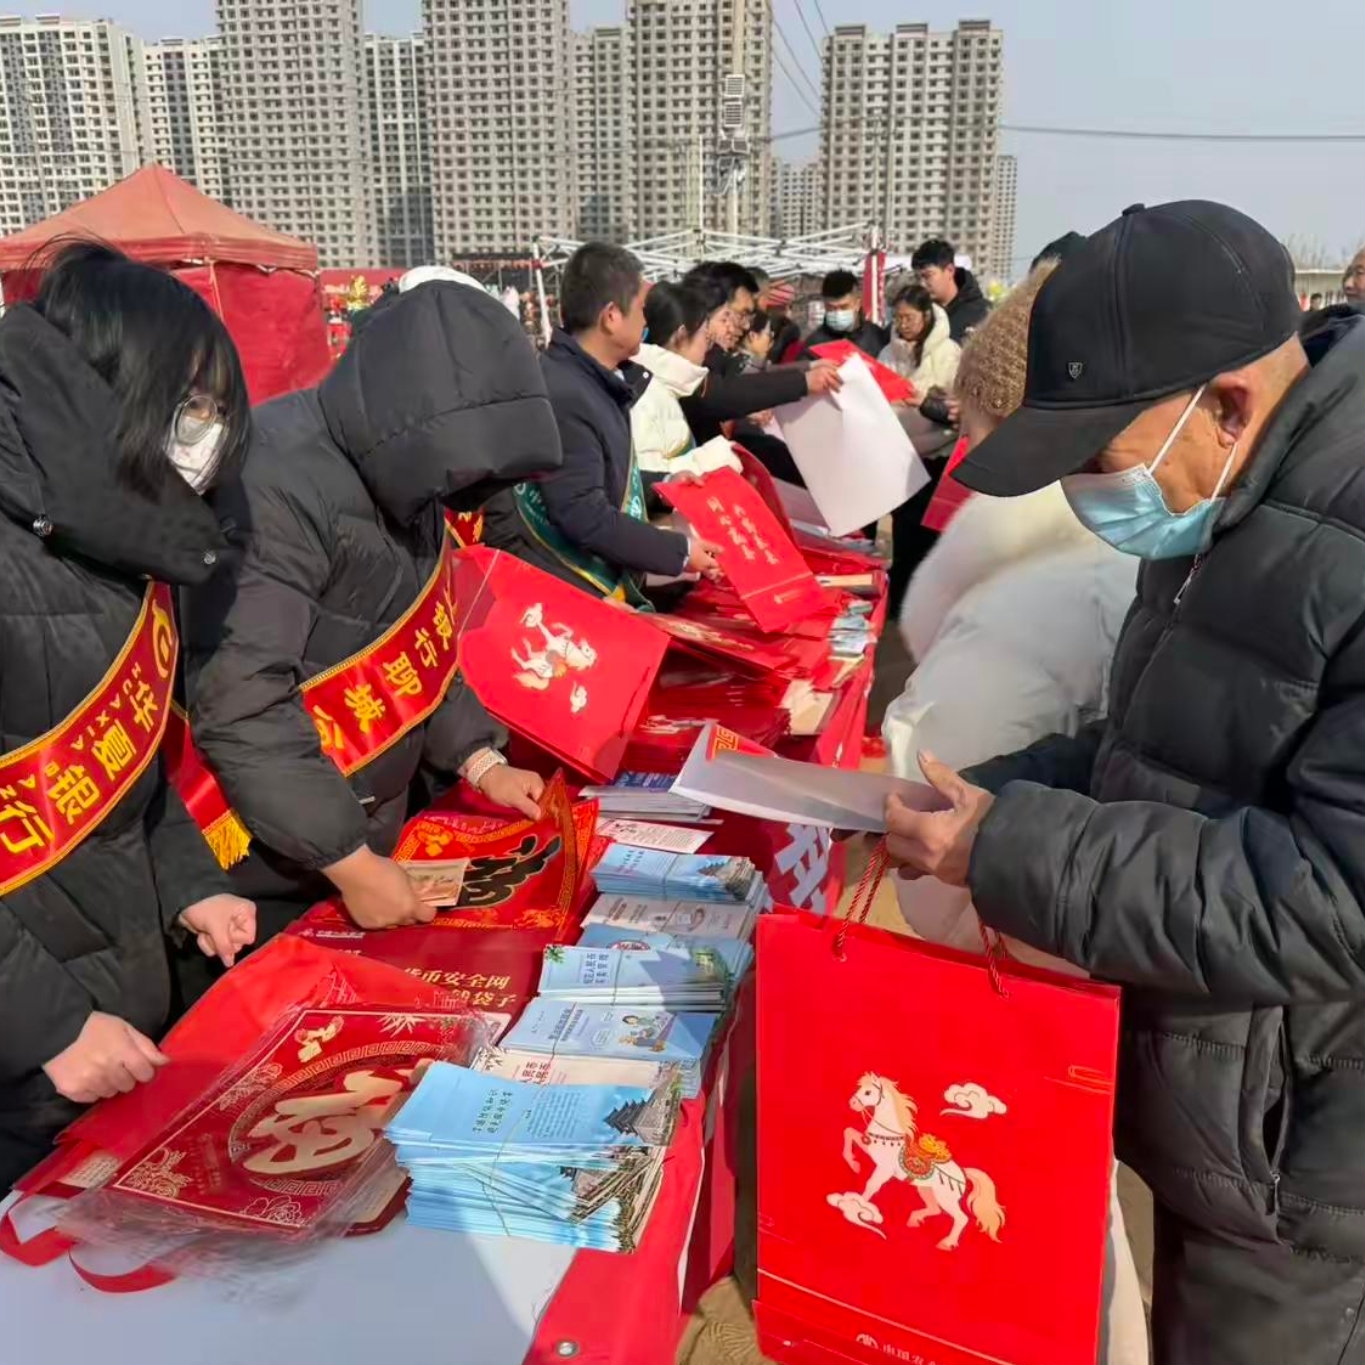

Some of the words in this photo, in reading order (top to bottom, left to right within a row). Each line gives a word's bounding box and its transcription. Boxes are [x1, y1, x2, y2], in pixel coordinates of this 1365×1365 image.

[0, 680, 158, 853] 华夏银行
[71, 661, 141, 750] HUAXIA
